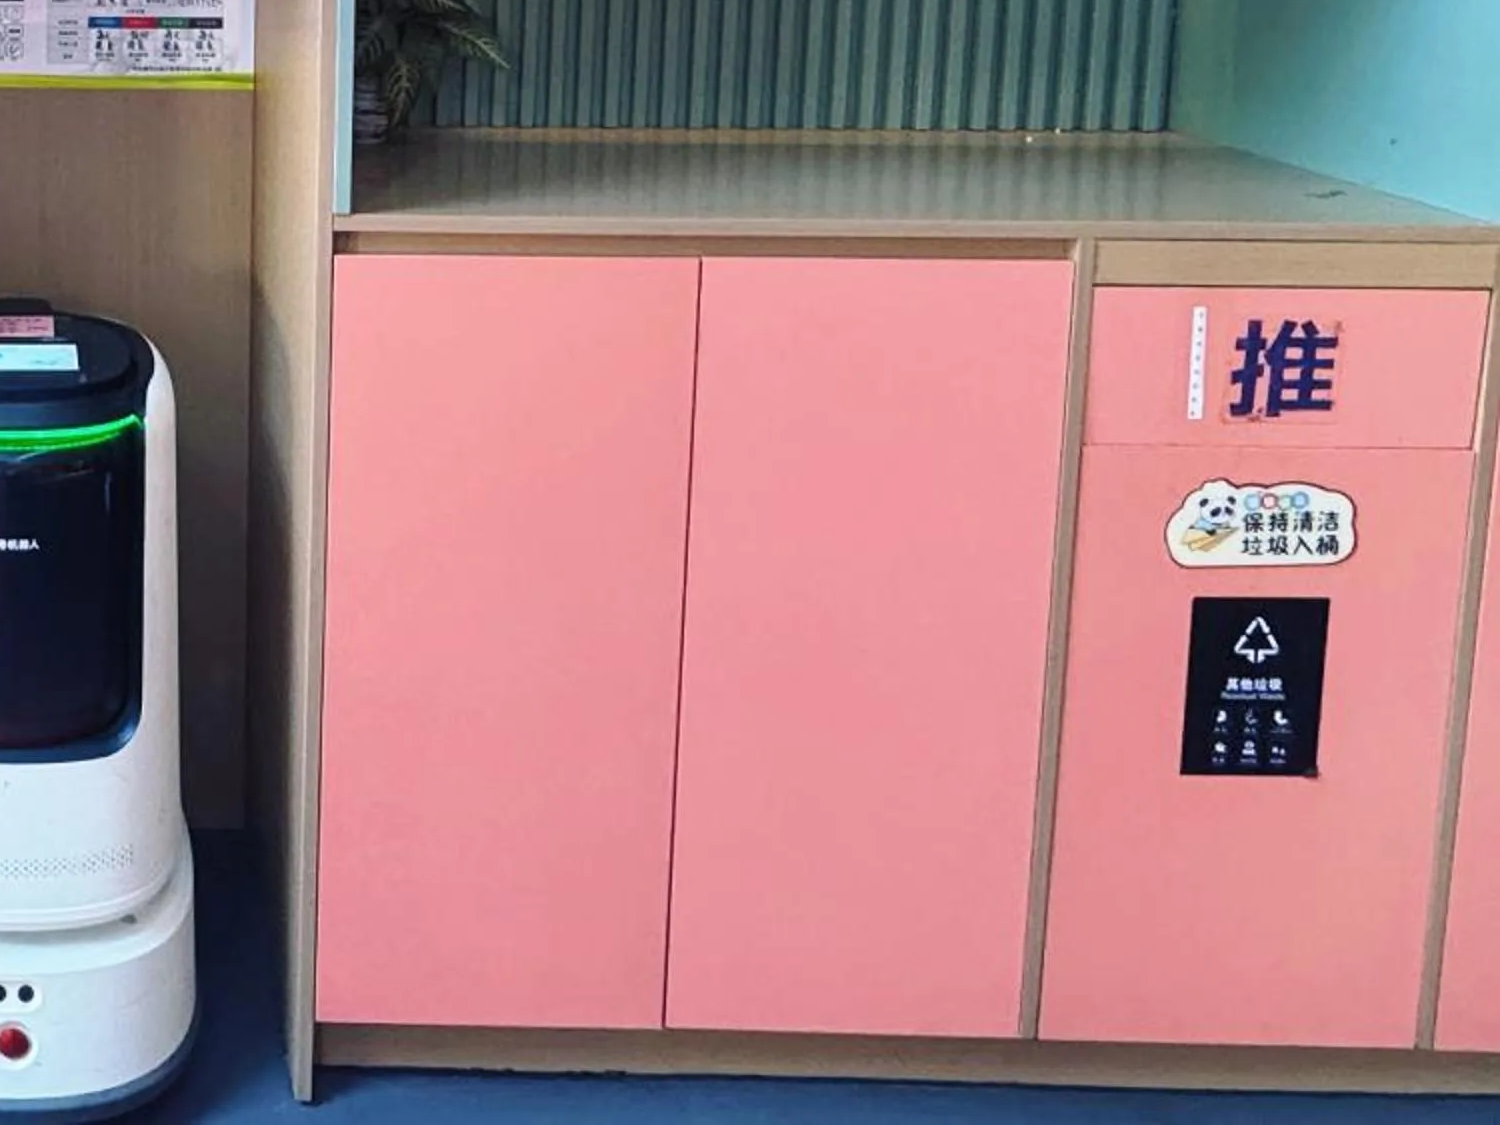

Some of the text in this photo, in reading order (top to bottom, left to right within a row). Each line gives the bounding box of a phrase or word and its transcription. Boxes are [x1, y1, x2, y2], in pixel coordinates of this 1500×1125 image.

[1229, 318, 1339, 418] 推
[1241, 511, 1340, 534] 保持清洁
[1241, 535, 1340, 557] 垃圾入桶
